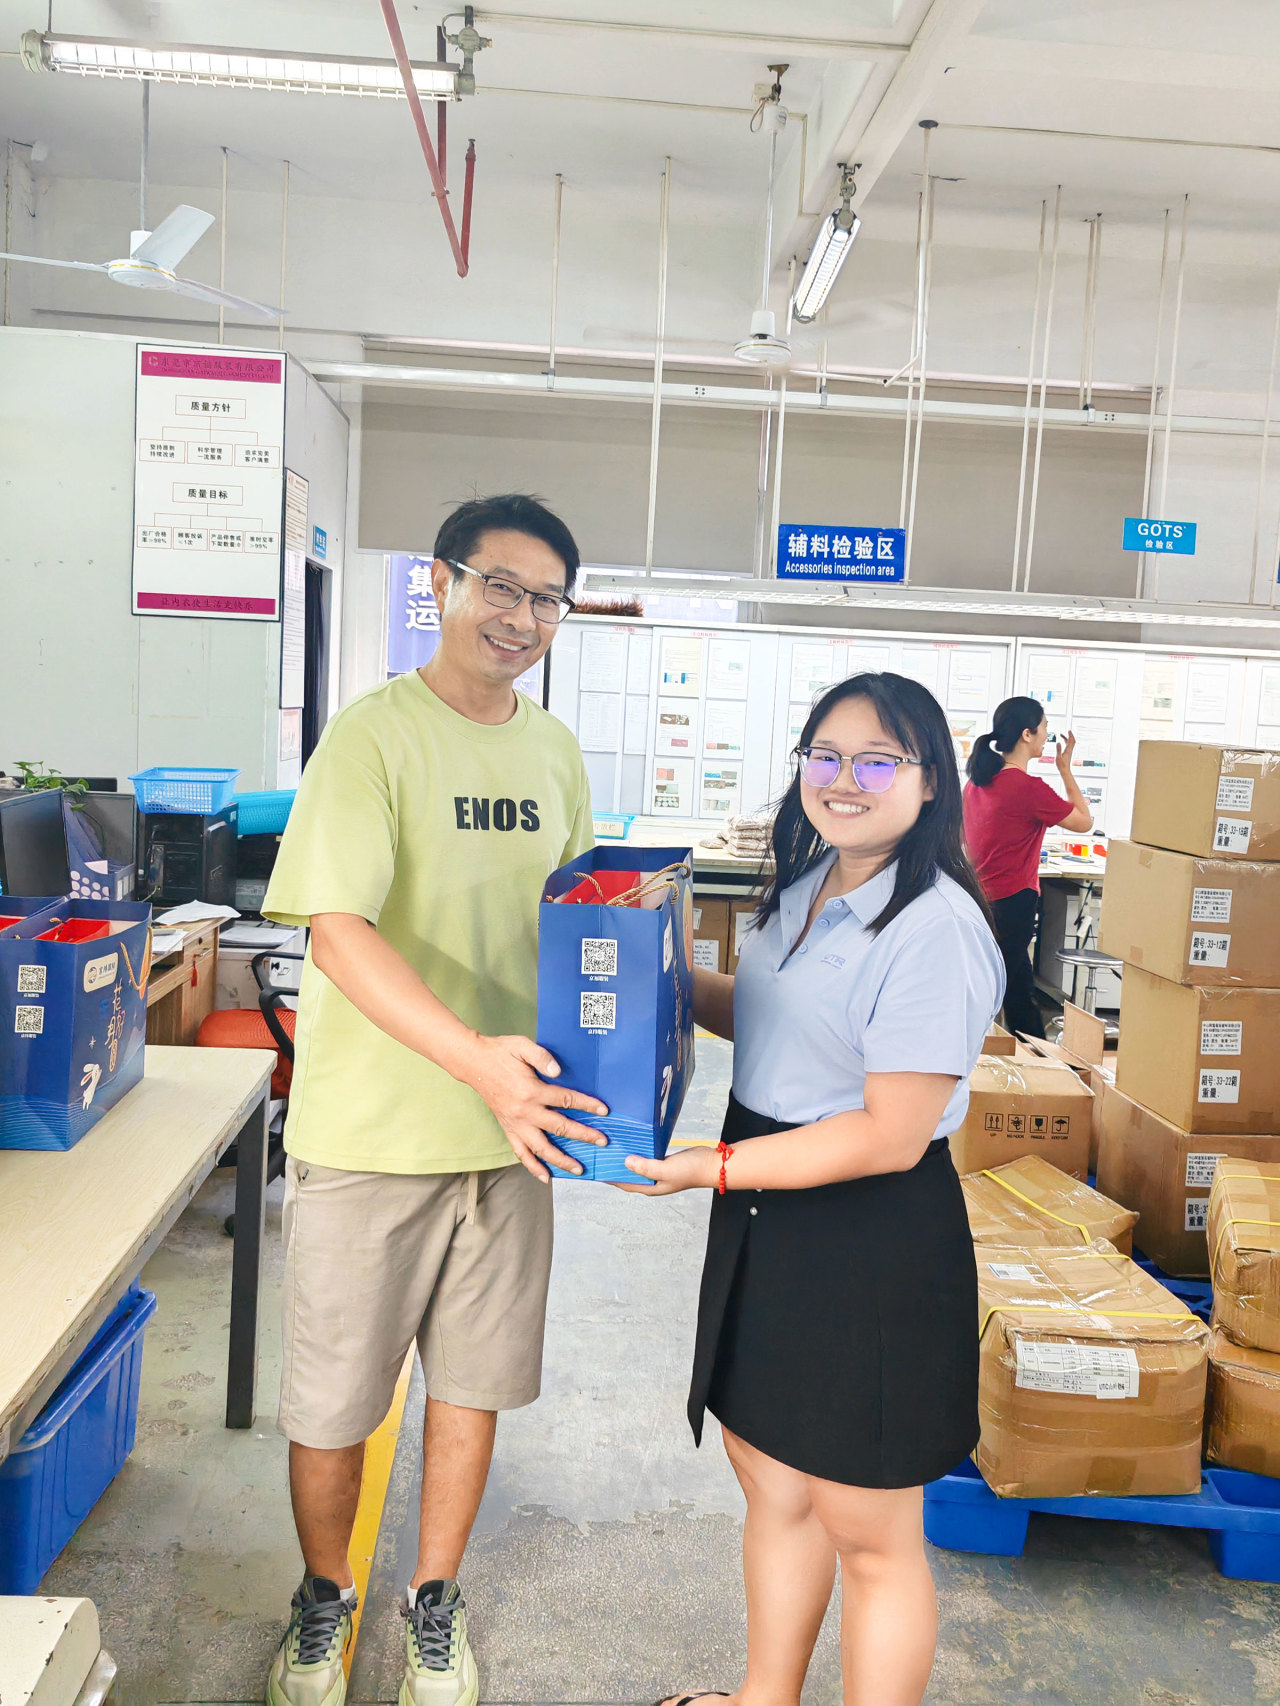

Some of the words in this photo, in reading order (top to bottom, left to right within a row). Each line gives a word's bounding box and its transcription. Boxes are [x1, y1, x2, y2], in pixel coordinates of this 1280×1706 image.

[190, 401, 231, 413] 质量方针
[188, 488, 228, 499] 质量目标
[1137, 522, 1183, 538] GOTS
[788, 533, 895, 560] 辅料检验区
[1145, 539, 1174, 550] 检验区
[785, 560, 832, 574] Accessories
[834, 562, 876, 577] inspection
[877, 565, 895, 576] area
[405, 555, 441, 632] 集运
[454, 796, 541, 833] ENOS
